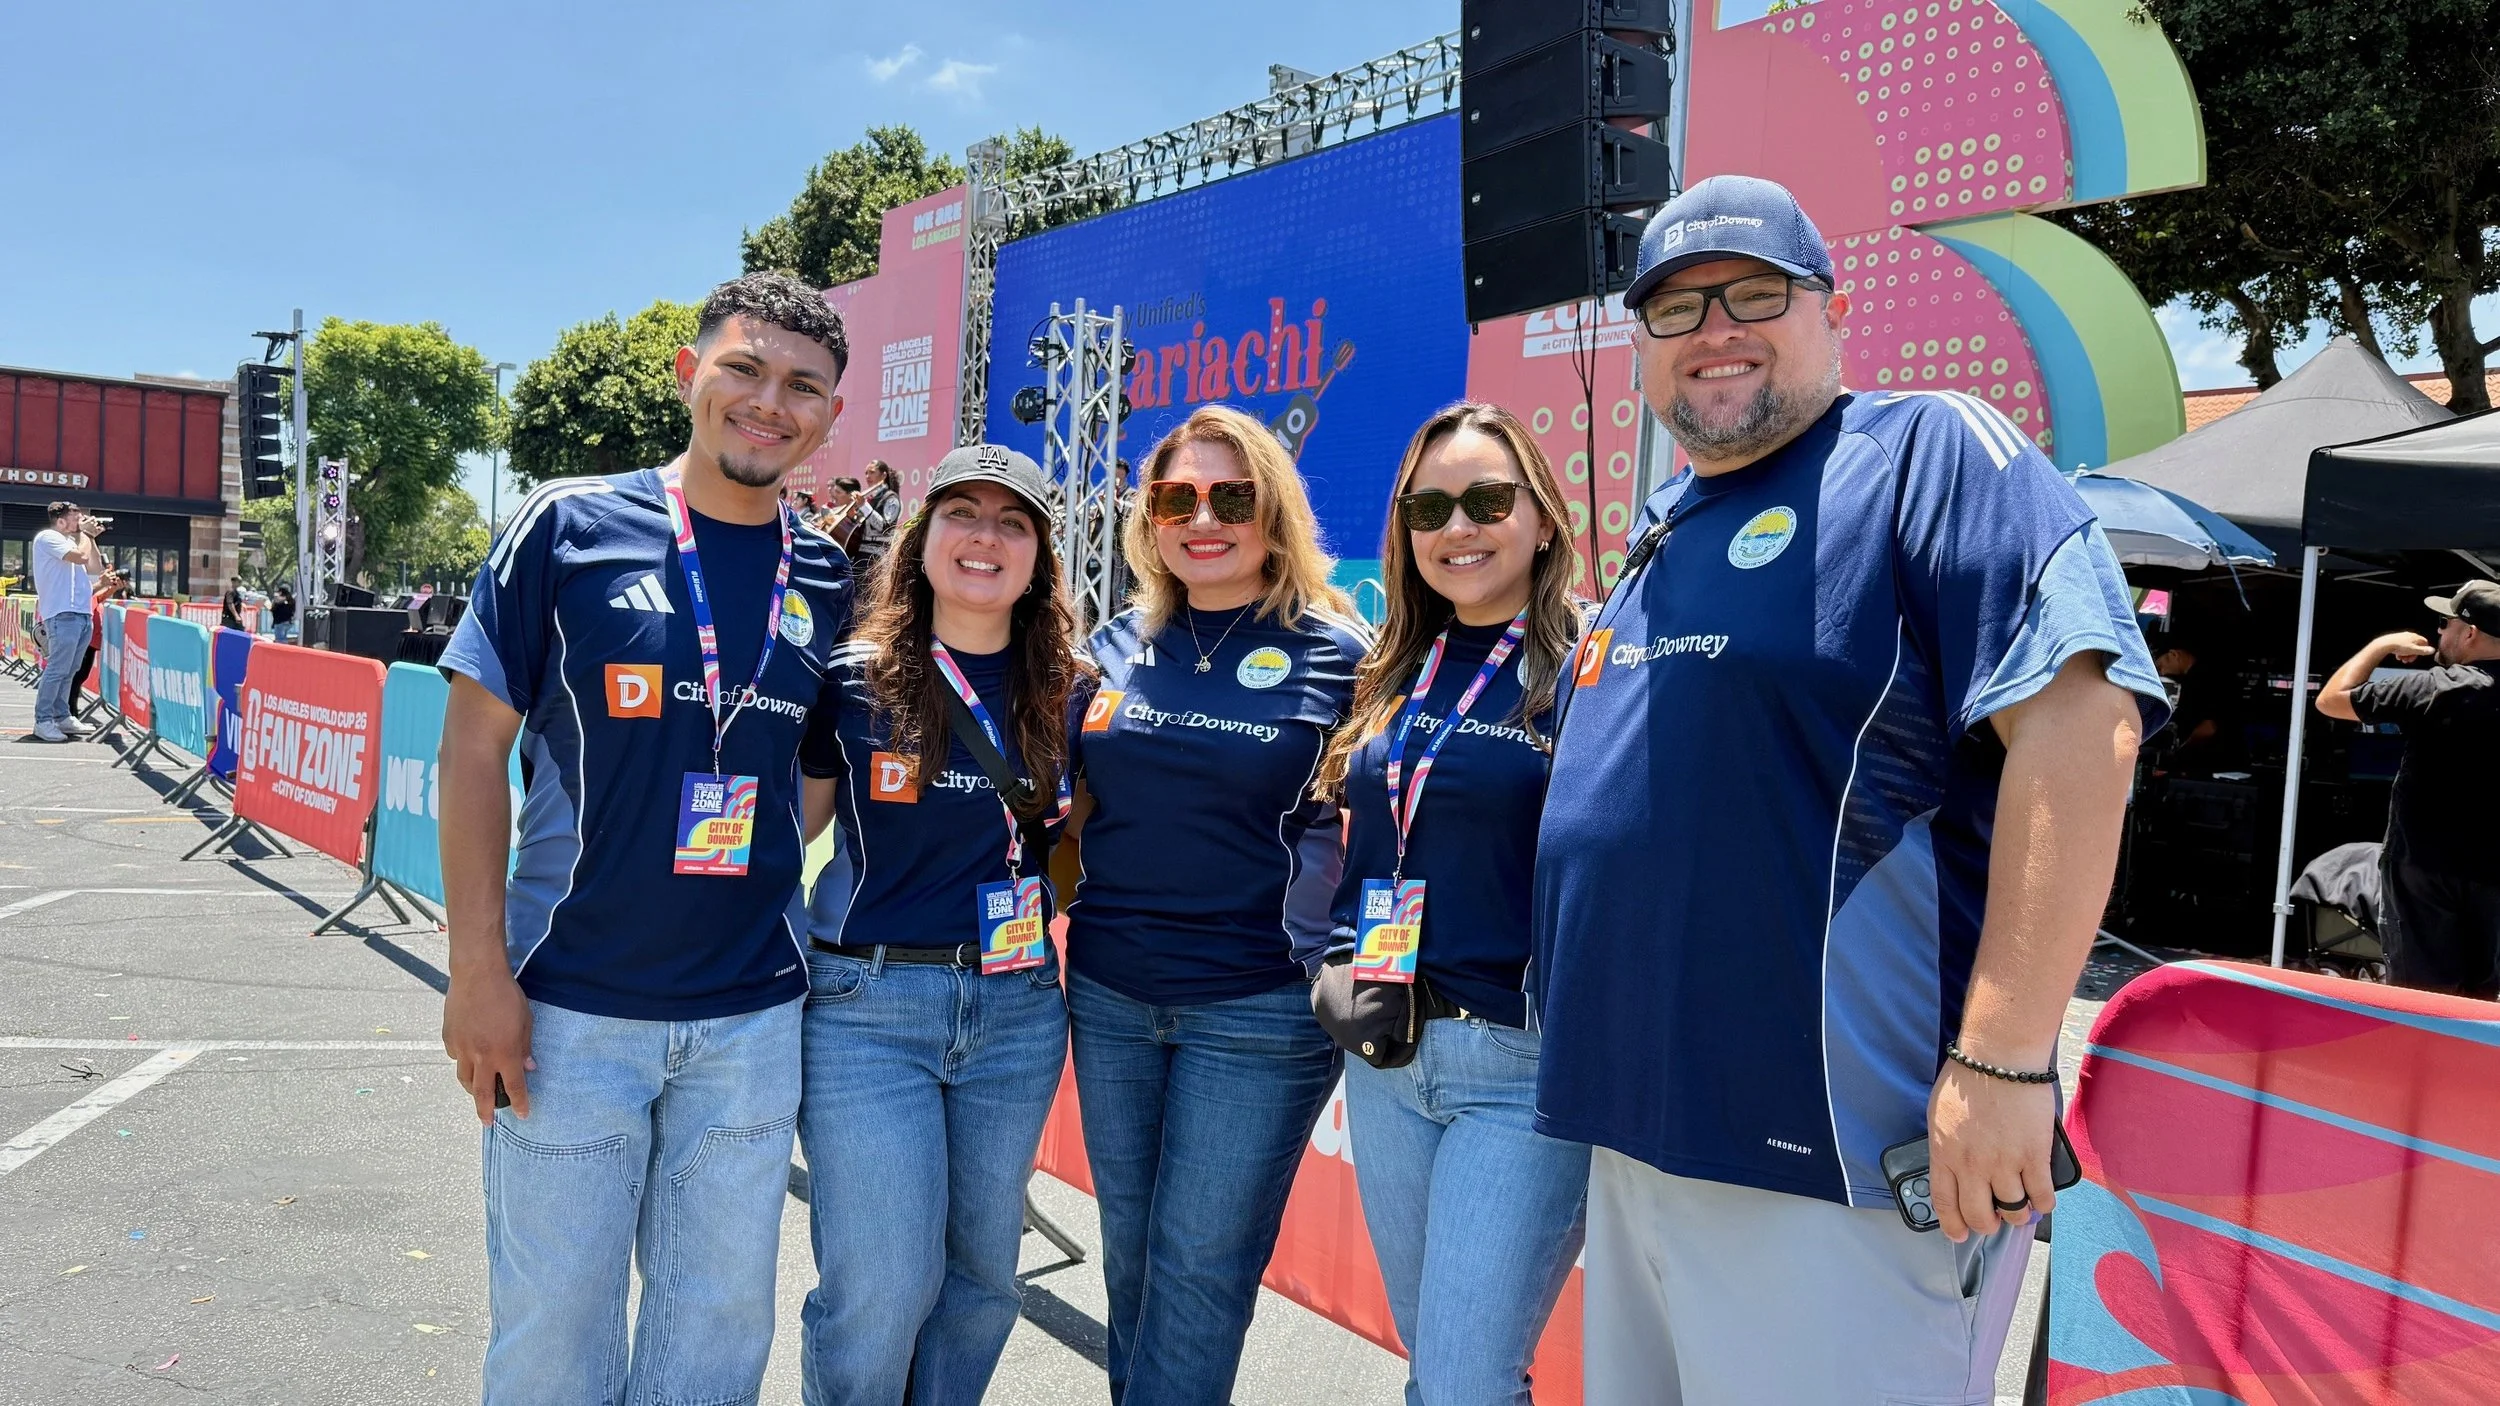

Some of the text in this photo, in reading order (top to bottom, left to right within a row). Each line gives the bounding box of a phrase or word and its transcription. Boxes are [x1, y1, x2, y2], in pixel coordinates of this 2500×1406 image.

[913, 200, 963, 234] WE ARE
[912, 223, 961, 251] LOS ANGELES
[1137, 291, 1206, 328] Unified's
[883, 335, 932, 354] LOS ANGELES
[1541, 342, 1552, 351] at
[1552, 336, 1574, 350] CITY
[883, 350, 906, 363] WORLD
[907, 347, 922, 359] CUP
[1128, 297, 1328, 410] ariachi
[892, 360, 932, 396] FAN
[879, 392, 930, 428] ZONE
[979, 446, 1008, 472] LA
[0, 468, 81, 486] HOUSE
[616, 674, 649, 709] D
[264, 693, 367, 731] LOS ANGELES WORLD CUP 26
[258, 712, 302, 780] FAN
[300, 724, 366, 801] ZONE
[386, 754, 425, 817] WE
[278, 779, 295, 800] CITY
[294, 785, 305, 803] OF
[304, 789, 338, 815] DOWNEY
[700, 790, 724, 800] FAN
[692, 799, 723, 810] ZONE
[709, 821, 745, 835] CITY OF
[707, 834, 743, 846] DOWNEY
[987, 904, 1015, 916] ZONE
[993, 896, 1014, 907] FAN
[1365, 905, 1392, 916] ZONE
[1372, 896, 1393, 907] FAN
[1006, 920, 1037, 936] CITY OF
[1379, 928, 1411, 941] CITY OF
[1006, 931, 1037, 945] DOWNEY
[1378, 940, 1409, 953] DOWNEY
[1766, 1137, 1813, 1156] AEROREADY
